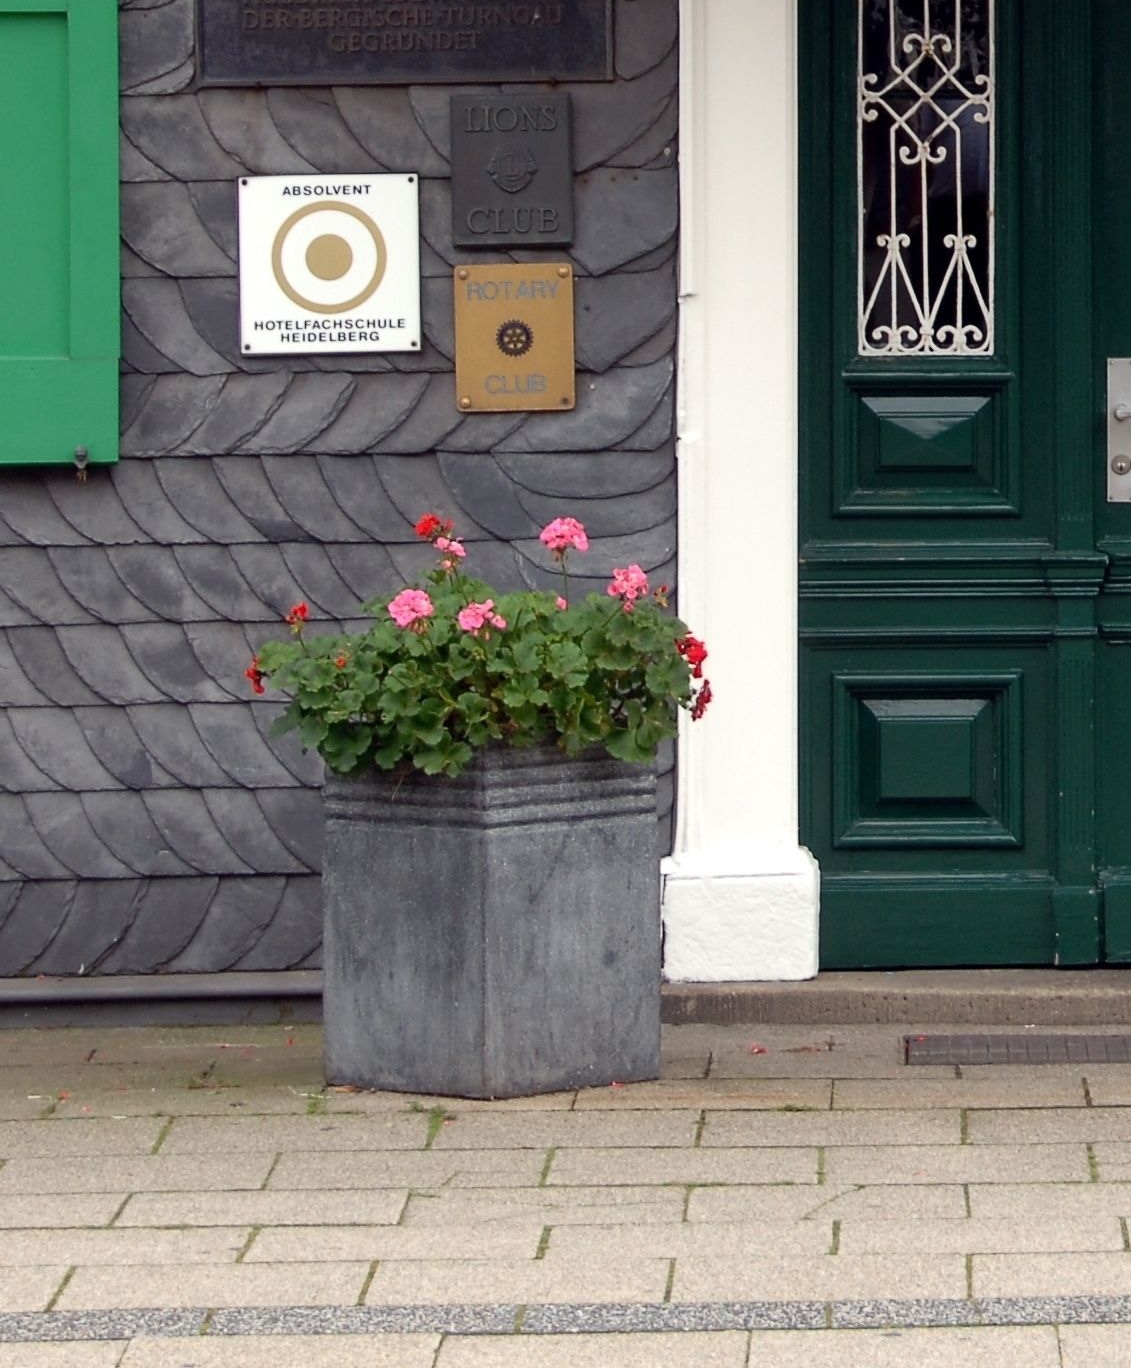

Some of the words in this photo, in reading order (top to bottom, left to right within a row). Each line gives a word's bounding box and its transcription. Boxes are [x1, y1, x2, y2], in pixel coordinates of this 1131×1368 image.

[242, 9, 291, 30] DER
[299, 7, 435, 29] BERGISCHE
[443, 5, 566, 27] TURNGAU
[464, 106, 558, 133] LIONS
[282, 185, 372, 196] ABSOLVENT
[466, 208, 560, 235] CLUB
[466, 280, 561, 302] ROTARY
[254, 319, 406, 331] HOTELFACHSCHULE
[280, 332, 380, 343] HEIDELBERG
[484, 374, 548, 395] CLUB
